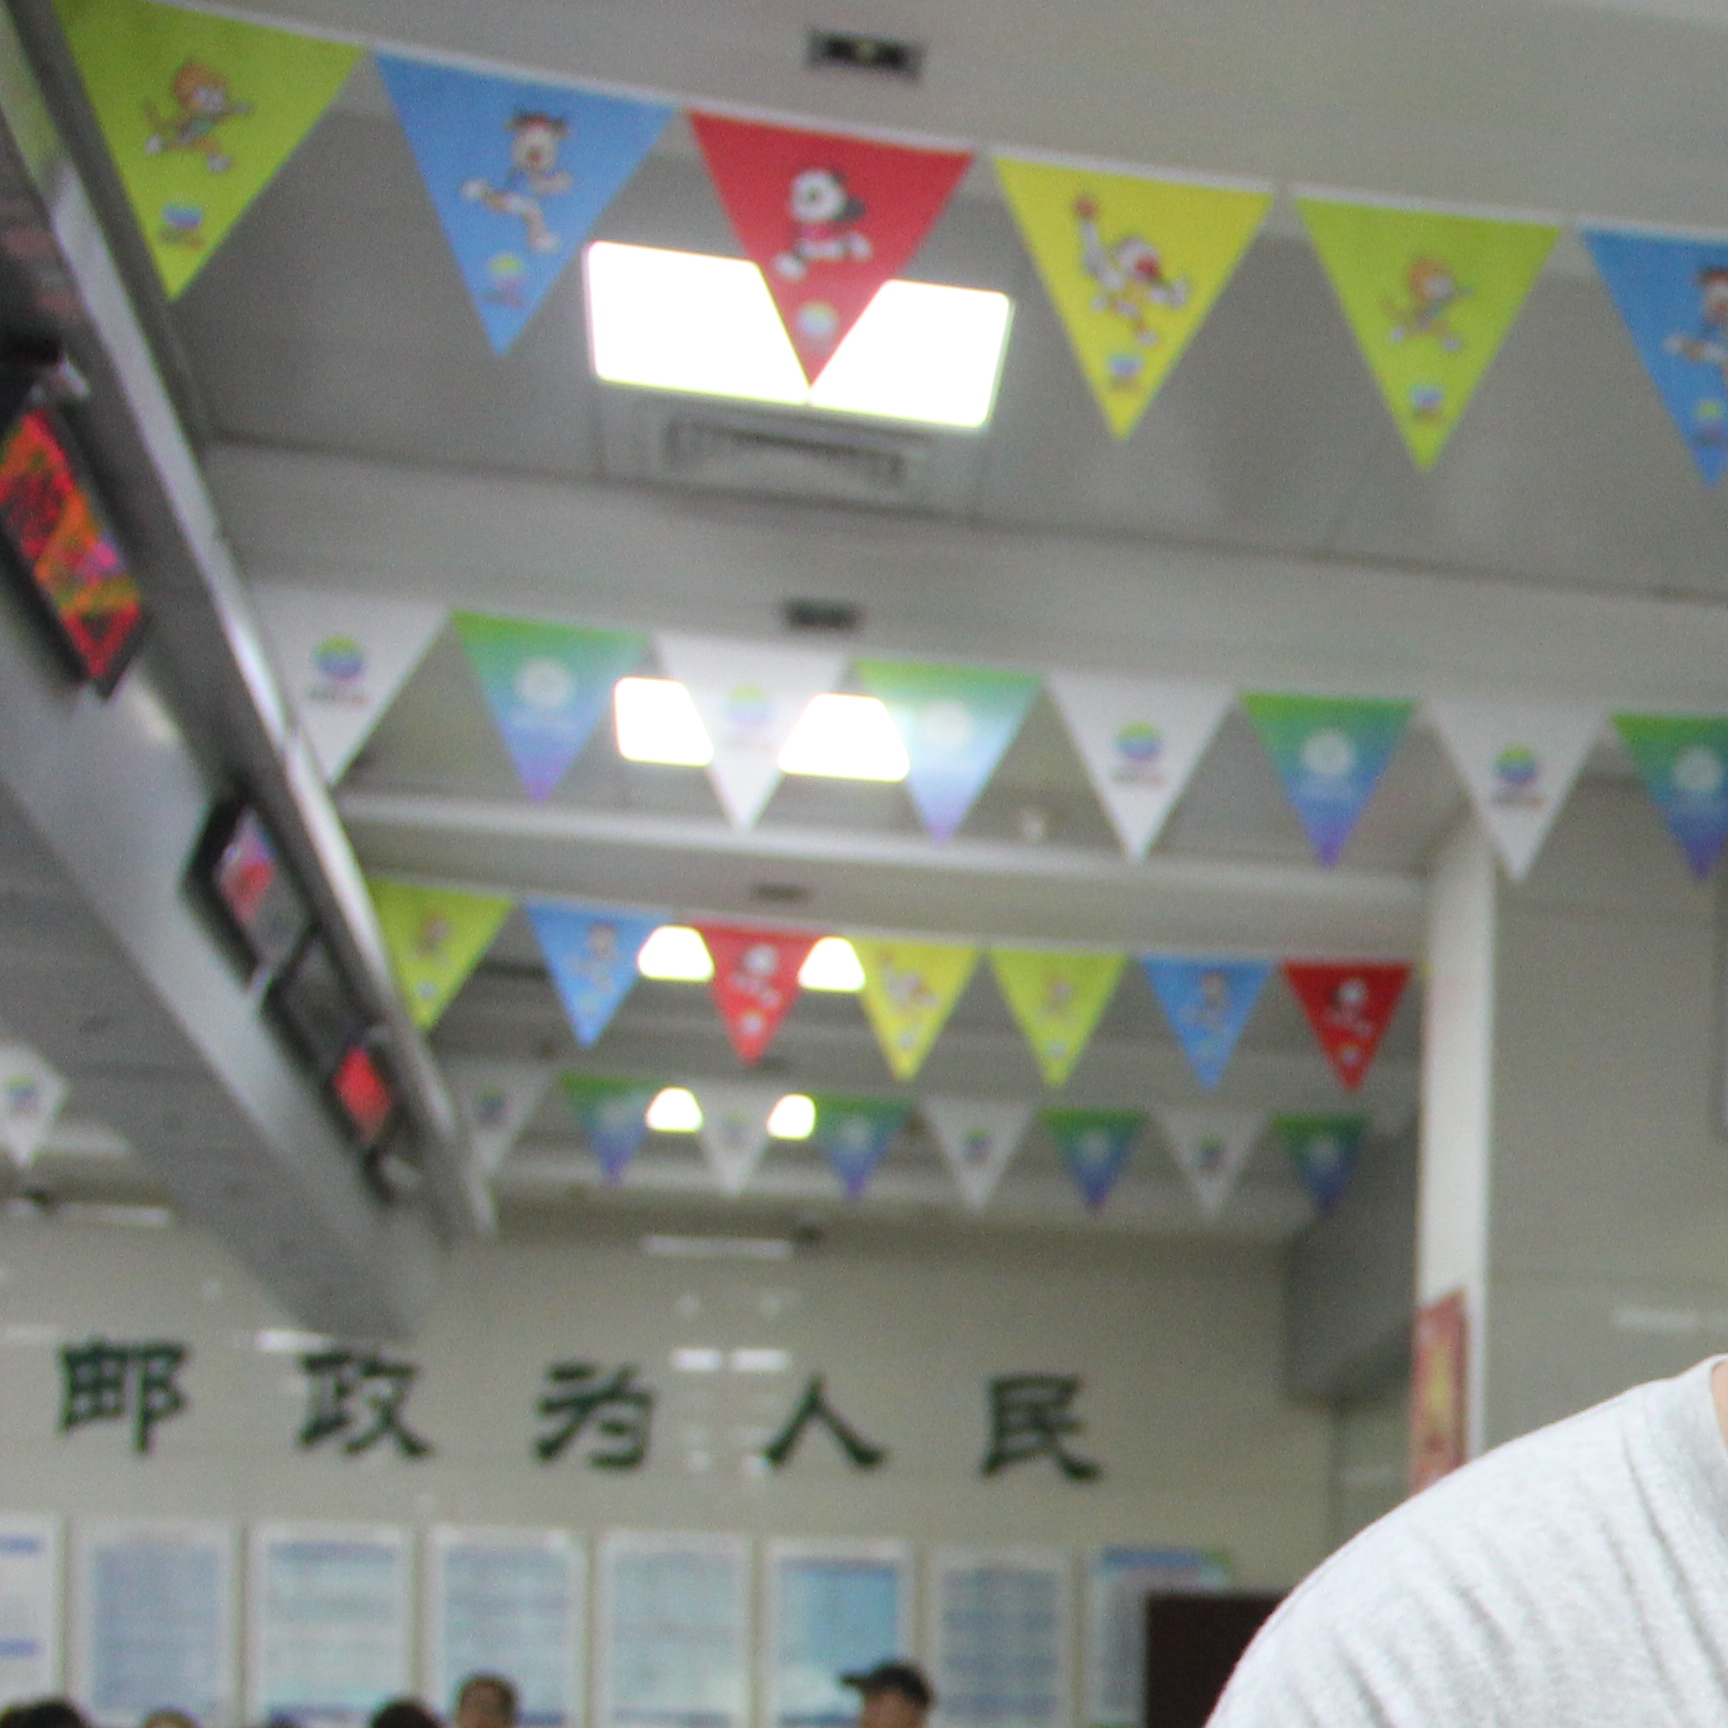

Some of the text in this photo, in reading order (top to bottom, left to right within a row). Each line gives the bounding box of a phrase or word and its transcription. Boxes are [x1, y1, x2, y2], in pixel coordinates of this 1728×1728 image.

[58, 1335, 1102, 1482] 邮政为人民
